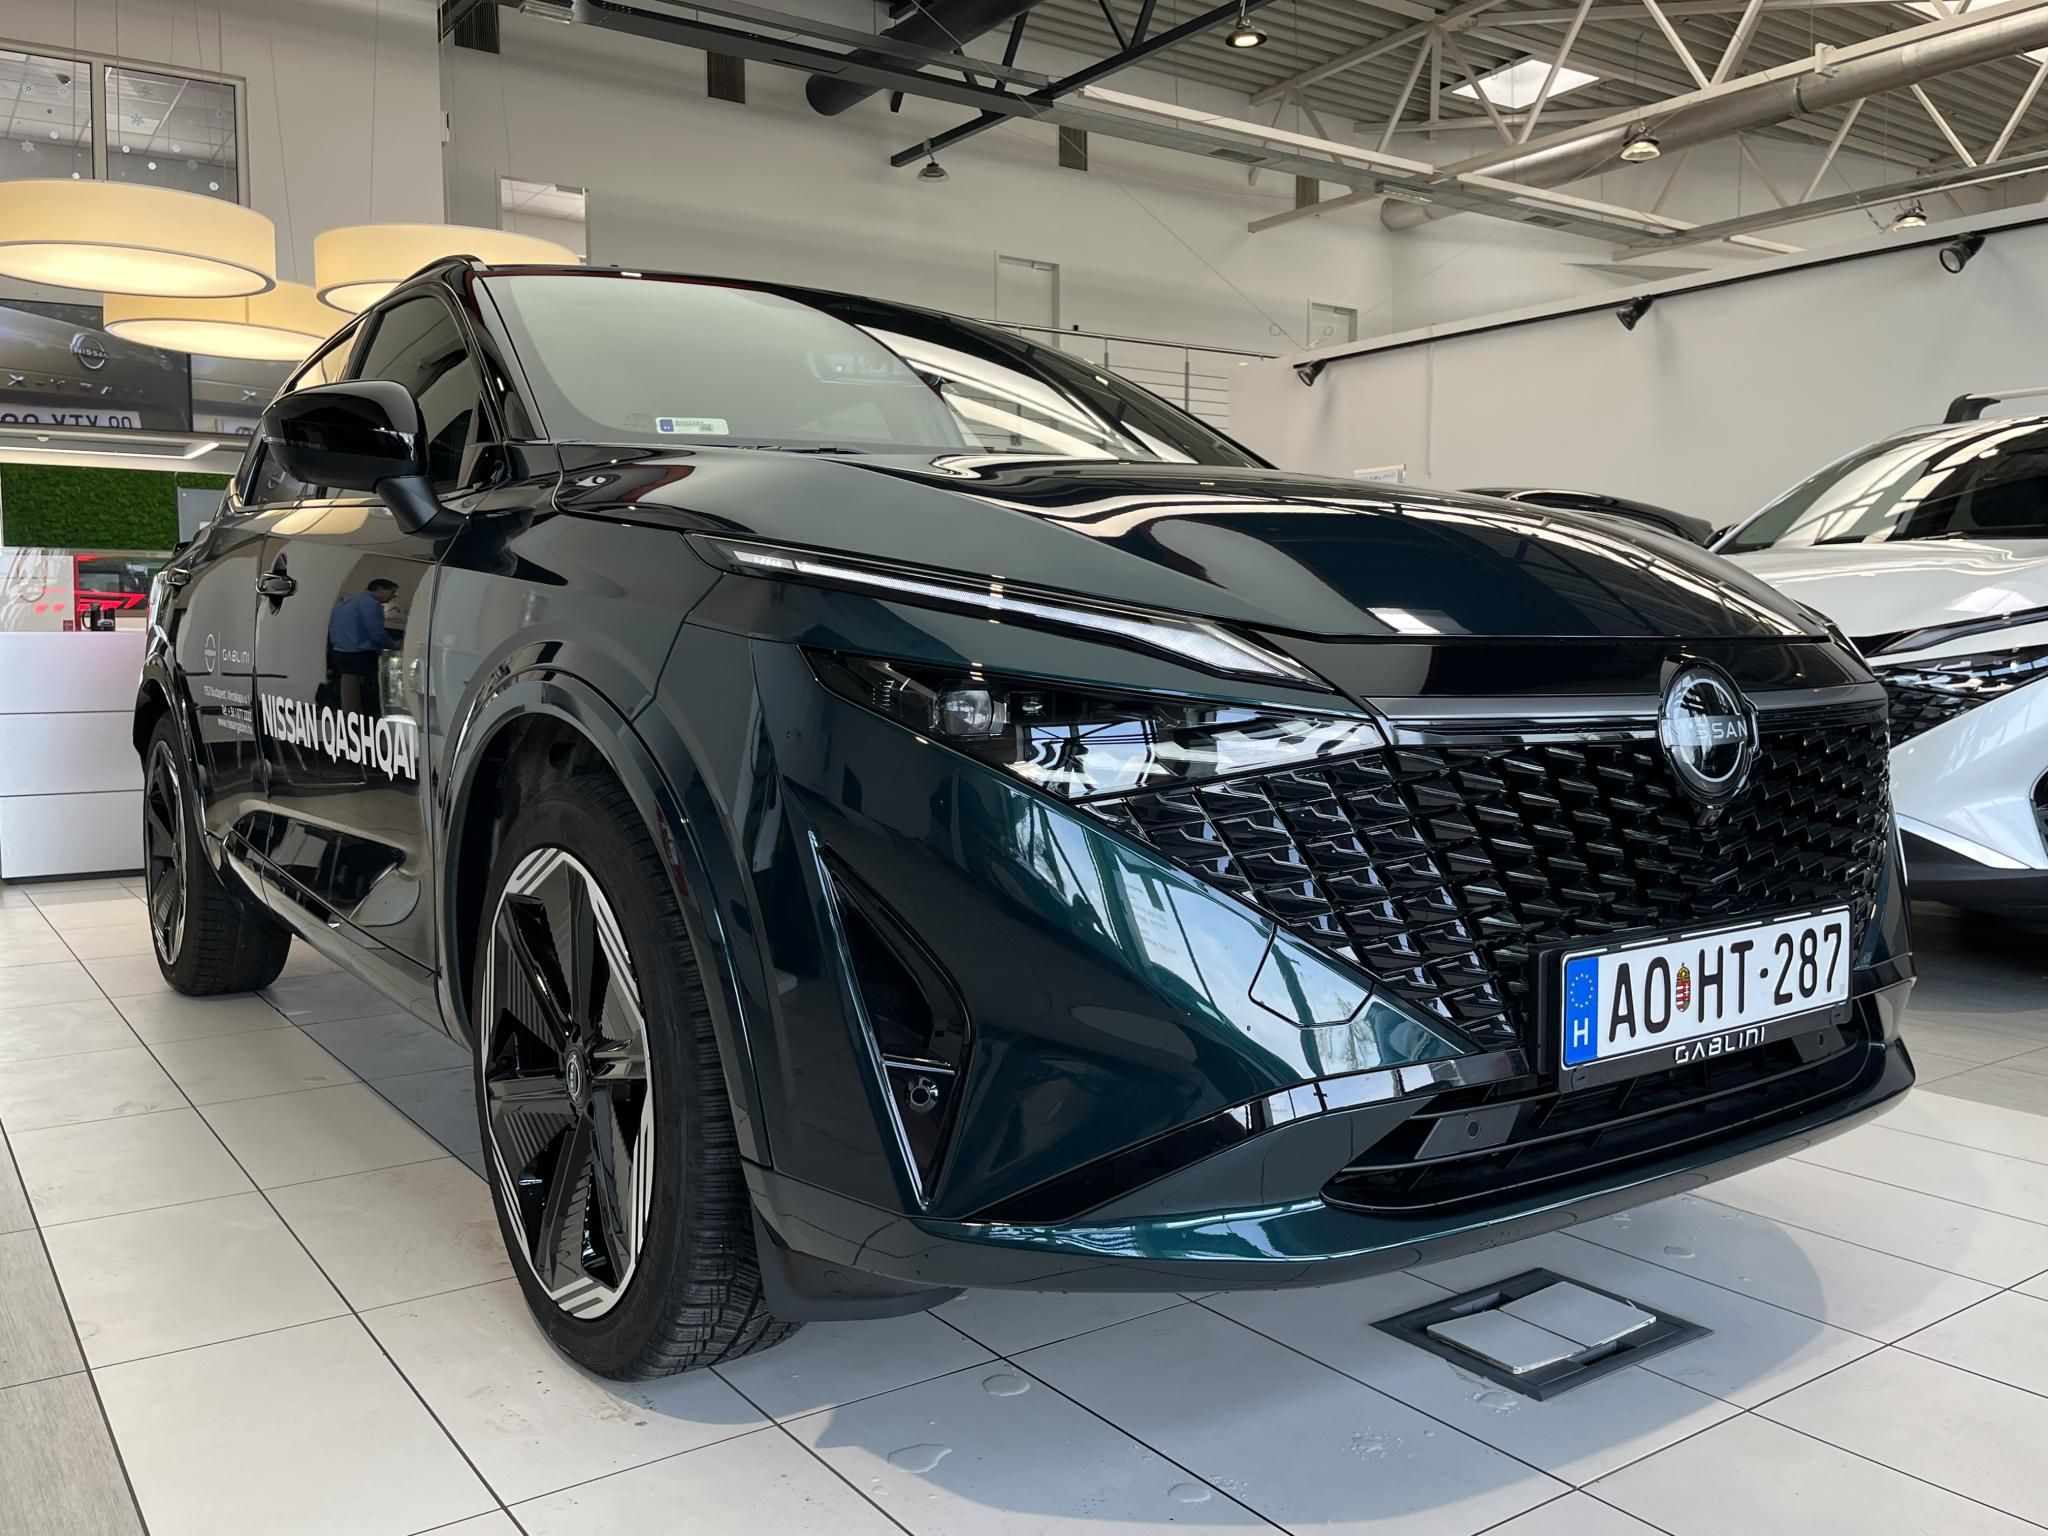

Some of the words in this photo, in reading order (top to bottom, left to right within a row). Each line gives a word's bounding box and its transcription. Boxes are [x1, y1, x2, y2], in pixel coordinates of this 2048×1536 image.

[261, 693, 319, 751] NISSAN
[321, 705, 416, 782] QASHQAI
[1667, 720, 1748, 739] SSAN
[1609, 956, 1671, 1043] AO
[1573, 1017, 1589, 1048] H
[1674, 1026, 1766, 1064] GABLINI
